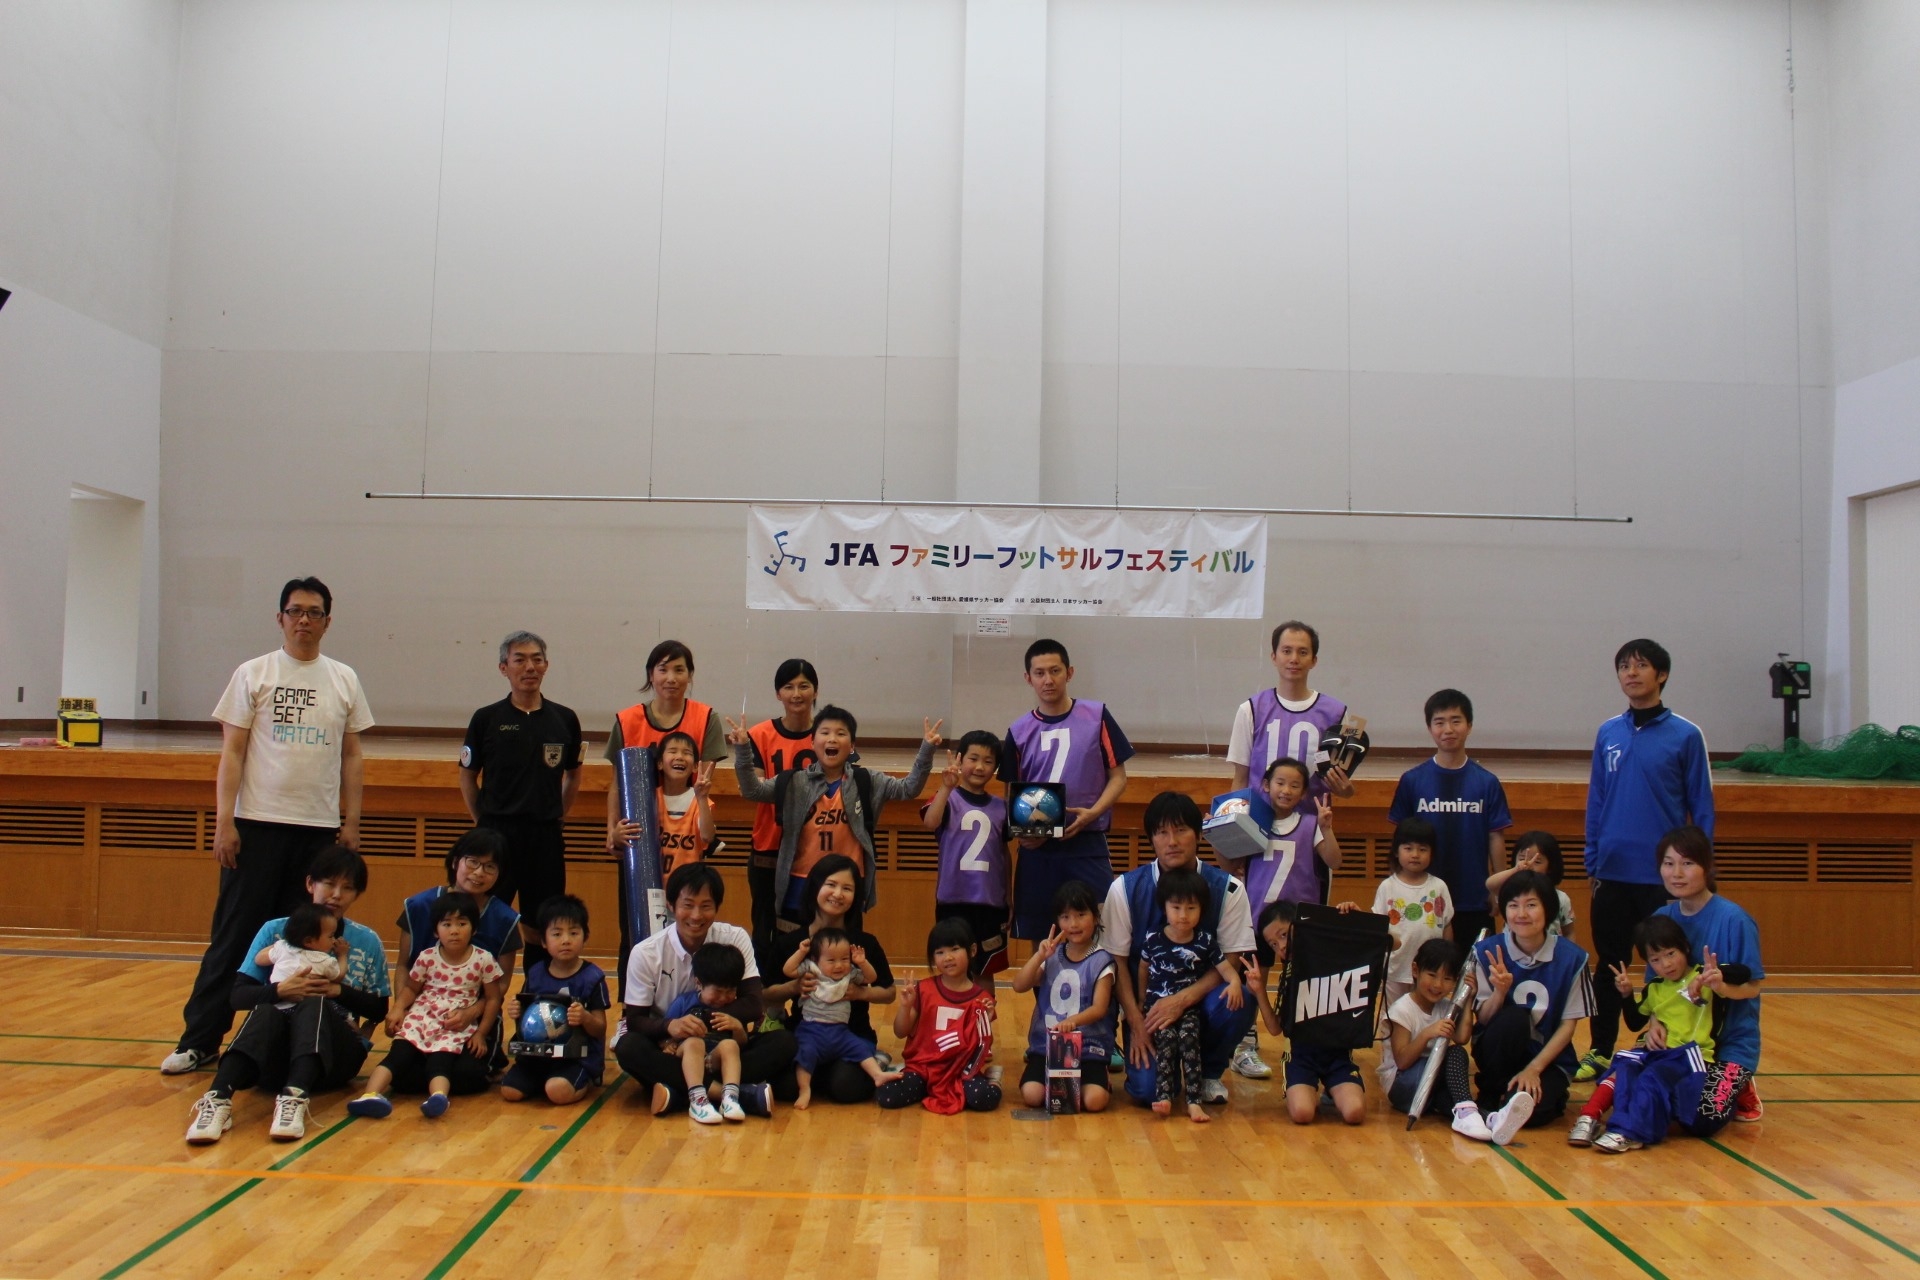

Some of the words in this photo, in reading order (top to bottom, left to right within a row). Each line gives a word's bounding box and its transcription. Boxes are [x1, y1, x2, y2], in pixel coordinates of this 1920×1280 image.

[824, 542, 880, 567] JFA
[889, 544, 1255, 574] ファミリーフットサルフェスティバル
[1040, 728, 1071, 783] 7
[1608, 749, 1621, 772] 17
[815, 808, 849, 825] asic
[1416, 797, 1484, 814] Admiral
[819, 831, 833, 851] 11
[959, 809, 992, 873] 2
[1262, 840, 1296, 903] 7
[1044, 968, 1081, 1031] 9
[1295, 965, 1370, 1023] NIKE
